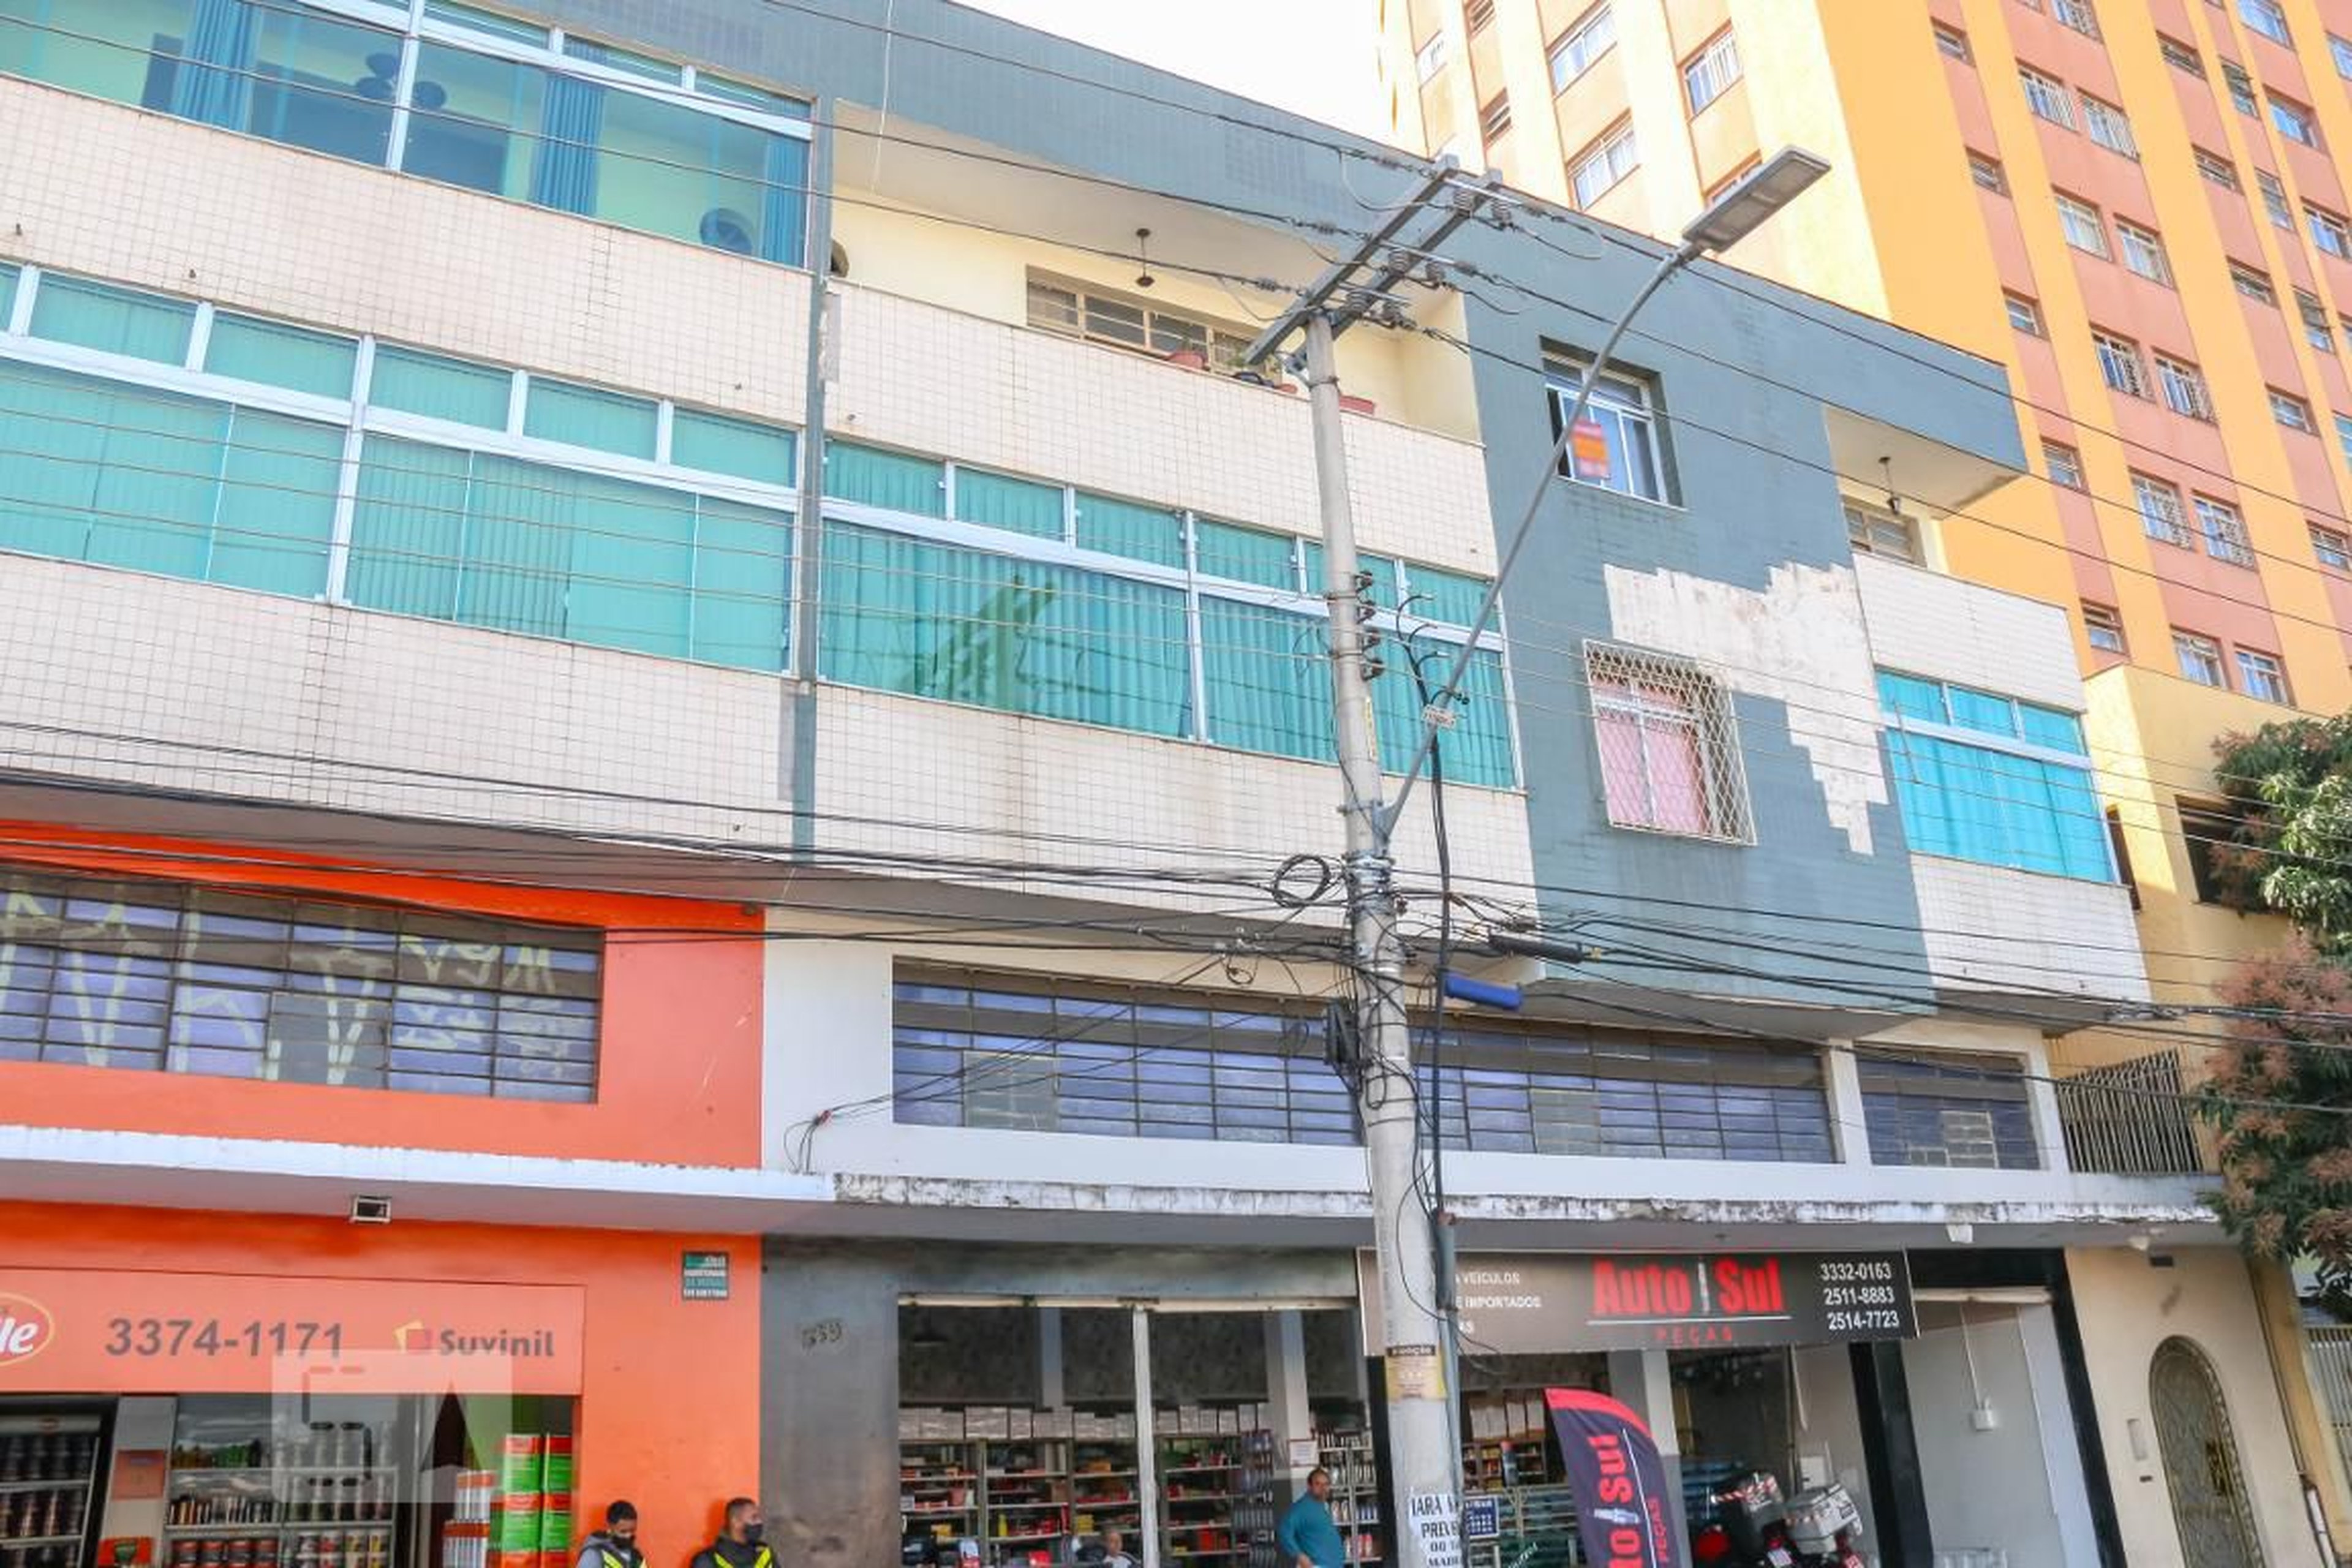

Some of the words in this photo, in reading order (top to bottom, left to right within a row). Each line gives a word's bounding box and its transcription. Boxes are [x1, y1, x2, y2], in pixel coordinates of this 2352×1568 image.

[1591, 1259, 1692, 1316] Auto
[1716, 1257, 1784, 1313] Sul
[1820, 1262, 1891, 1281] 3332-0163
[105, 1317, 342, 1357] 3374-1171
[1827, 1310, 1899, 1330] 2514-7723
[440, 1329, 555, 1358] Suvinil
[1588, 1434, 1634, 1503] Sul
